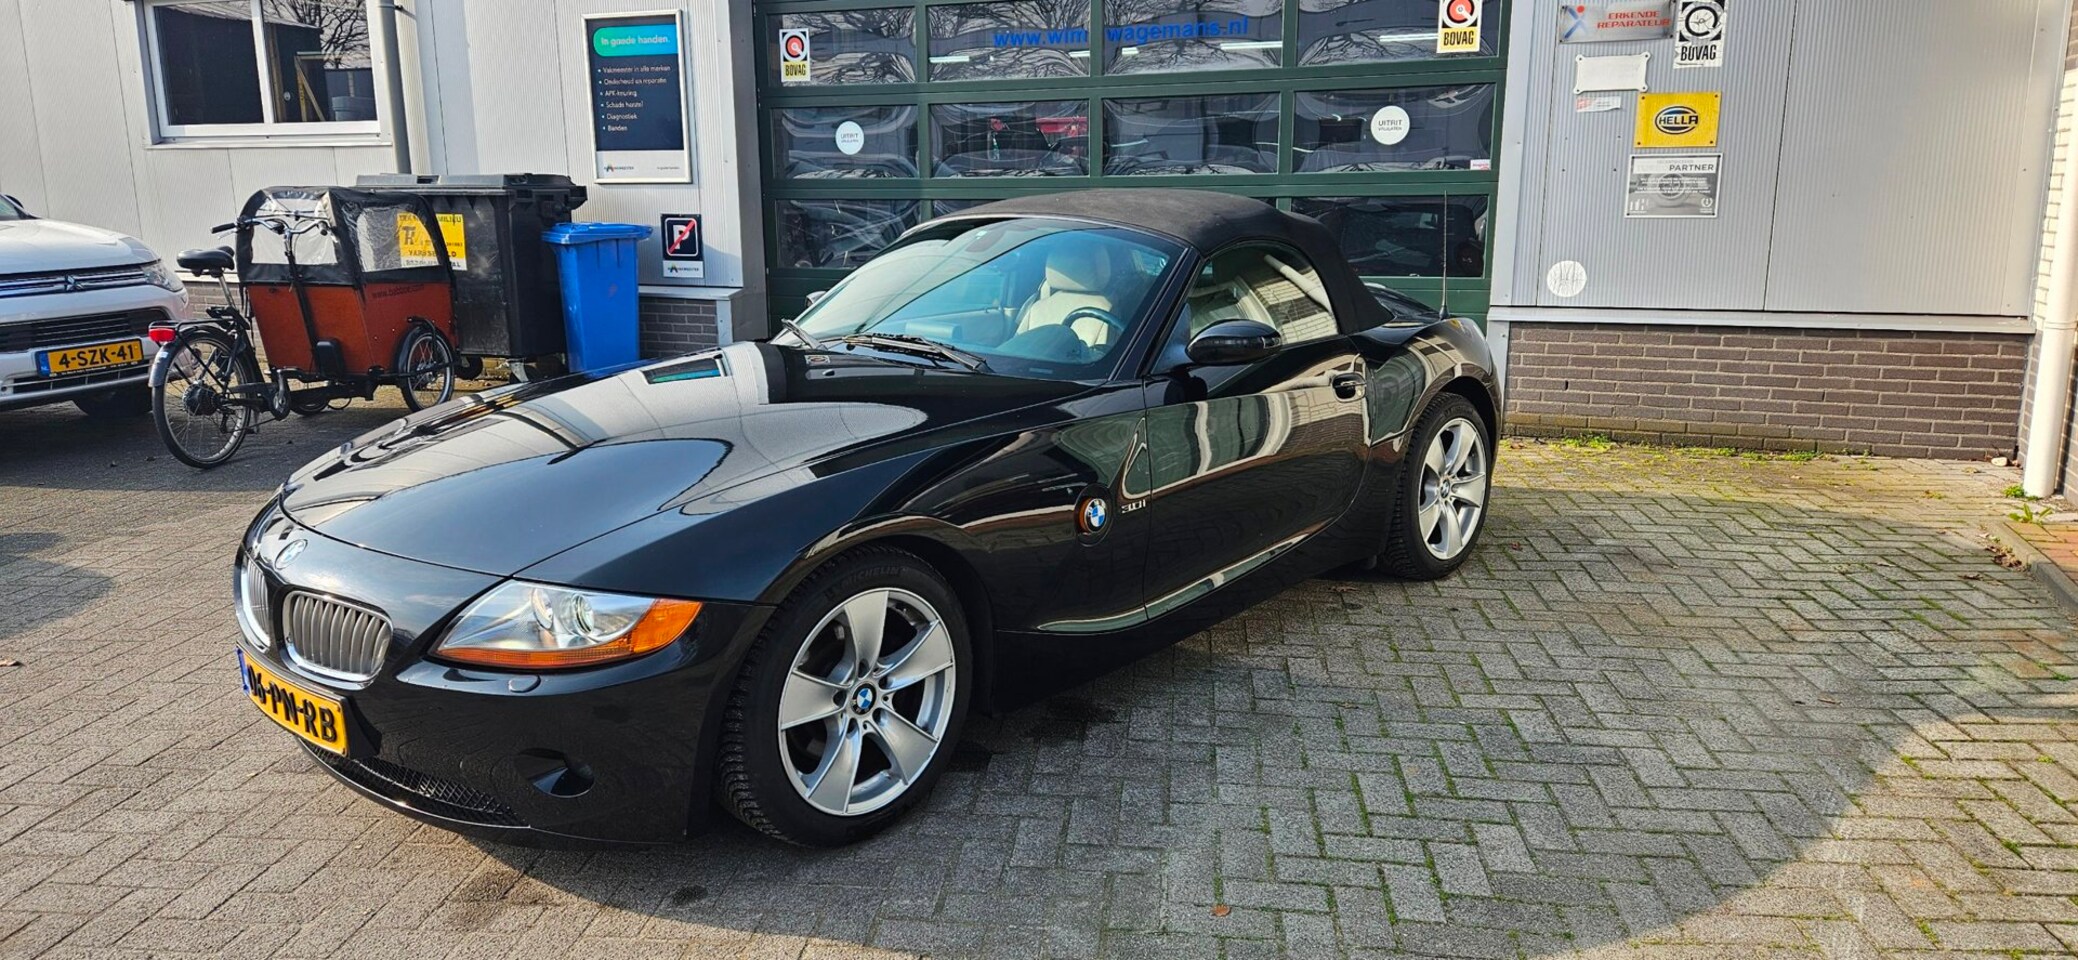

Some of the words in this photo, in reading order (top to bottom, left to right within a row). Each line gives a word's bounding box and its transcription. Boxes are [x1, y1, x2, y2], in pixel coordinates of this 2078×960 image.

[1608, 10, 1660, 20] ERKENDE
[1596, 18, 1671, 29] REPARATEUR
[1106, 17, 1248, 45] wagemans.nl
[601, 37, 609, 45] In
[610, 36, 635, 47] goede
[1443, 31, 1474, 46] BOVAG
[1680, 45, 1717, 62] BOVAG
[785, 63, 806, 77] BOVAG
[1658, 115, 1699, 125] HELLA
[1669, 163, 1715, 172] PARTNER
[59, 345, 134, 368] 4-SZK-41
[247, 664, 338, 743] 06-PN-RB
